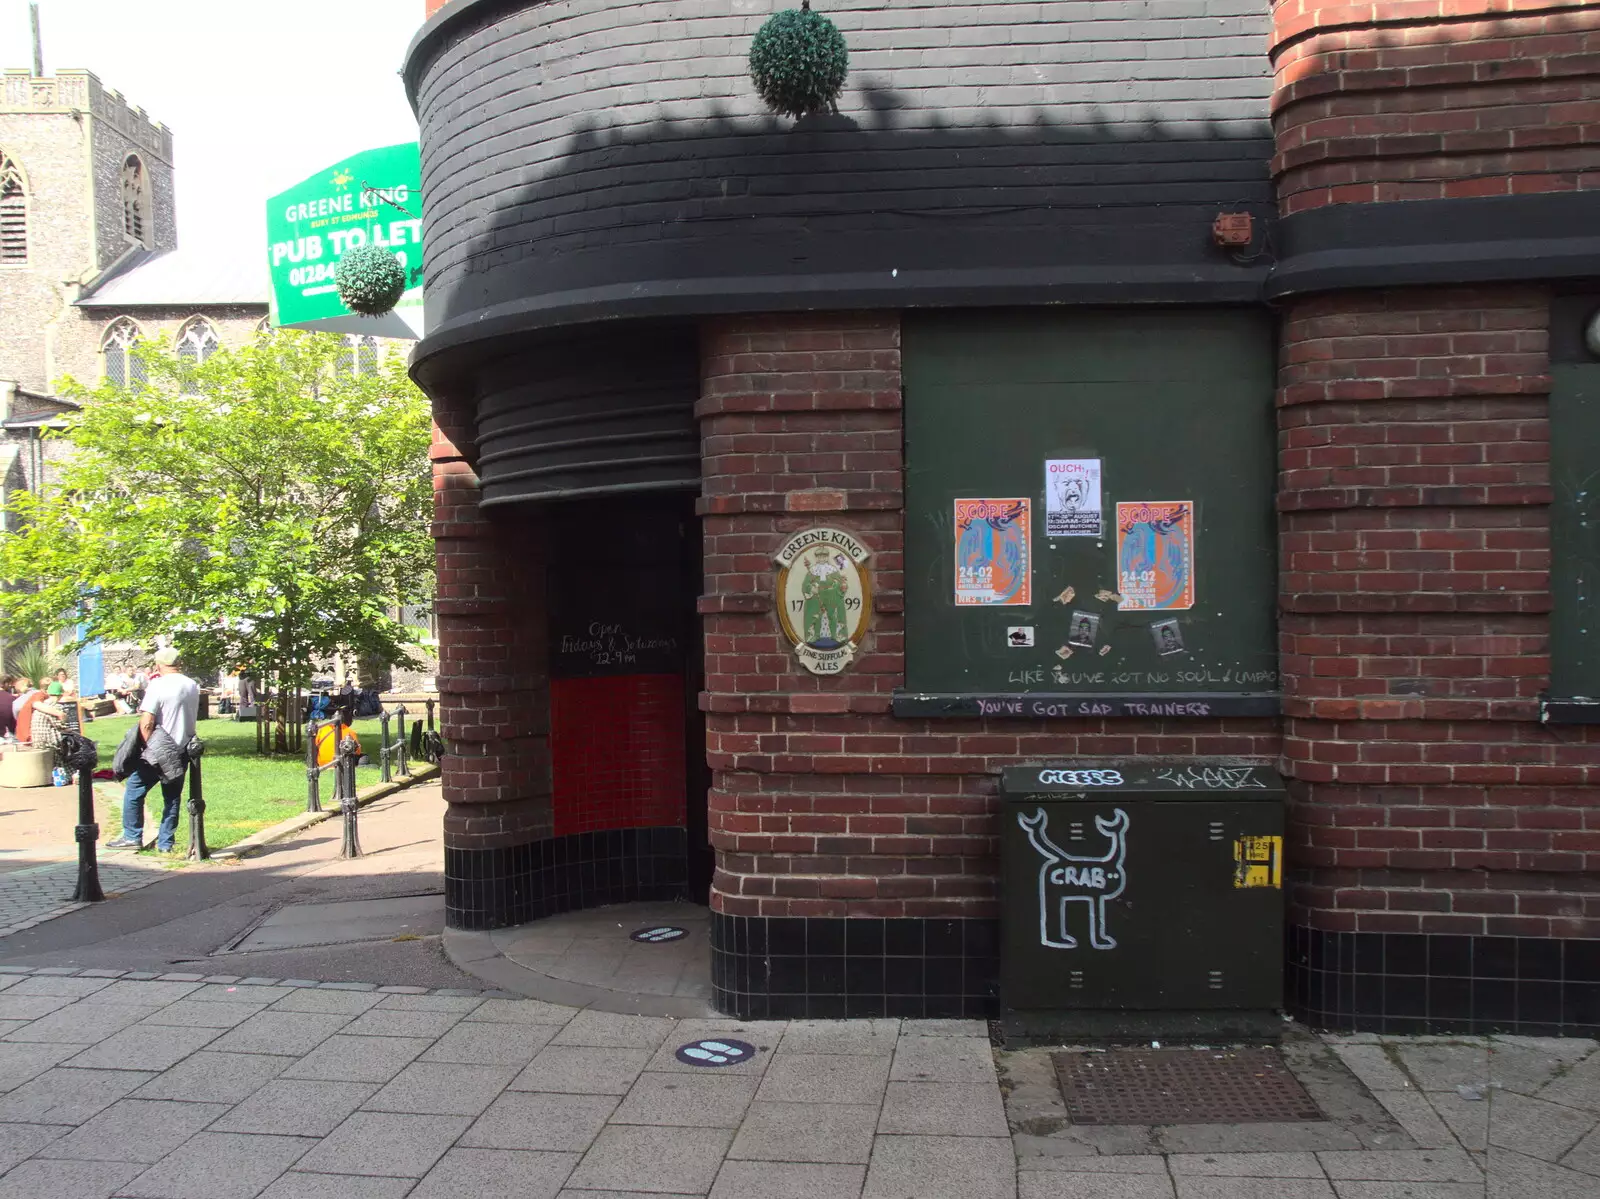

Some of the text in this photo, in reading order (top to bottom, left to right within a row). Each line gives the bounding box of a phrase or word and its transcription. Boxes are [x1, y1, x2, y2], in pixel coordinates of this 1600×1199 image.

[285, 184, 409, 222] GREENE KING
[311, 210, 379, 228] BURY ST EDMUNDS
[272, 218, 423, 267] PUB TO LET
[289, 262, 335, 286] 01284
[957, 504, 1010, 519] SCOPE
[1119, 507, 1171, 523] SCOPE
[782, 530, 863, 561] GREENE KING
[959, 566, 993, 578] 24-02
[1121, 570, 1157, 582] 24-02
[791, 597, 861, 612] 17 99
[588, 621, 622, 639] Open
[802, 648, 847, 661] FINE SUFFOLK
[814, 662, 839, 671] ALES
[1008, 670, 1045, 684] LIKE
[1147, 671, 1169, 684] NO
[977, 699, 1023, 715] YOU'VE
[1033, 701, 1069, 716] GOT
[1078, 702, 1113, 715] SAD
